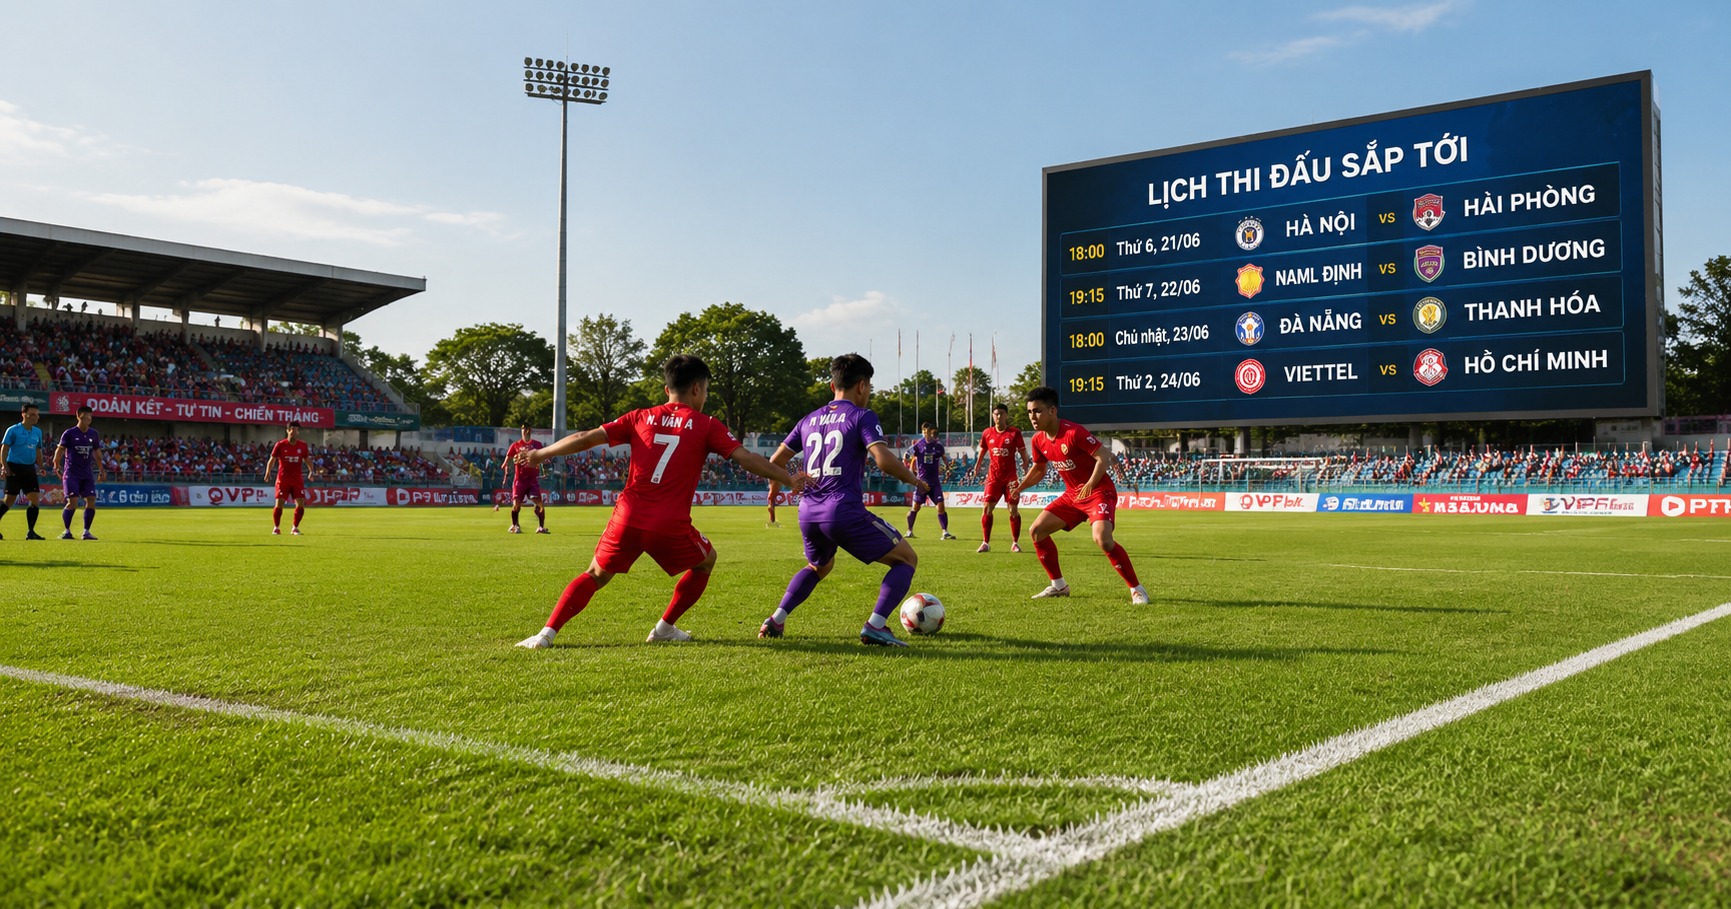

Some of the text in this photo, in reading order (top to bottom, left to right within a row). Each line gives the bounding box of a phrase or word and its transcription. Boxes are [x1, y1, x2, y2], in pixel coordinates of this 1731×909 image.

[1148, 132, 1468, 210] LỊCH THI ĐẤU SẮP TỚI
[1510, 184, 1596, 212] PHÒNG
[1286, 213, 1314, 238] HÀ
[1319, 210, 1355, 236] NỘI
[1069, 243, 1105, 261] 18:00
[1116, 232, 1201, 256] Thứ 6, 21/06
[1463, 245, 1515, 270] BÌNH
[1522, 238, 1605, 264] DƯƠNG
[1275, 262, 1362, 286] NAML ĐỊNH
[1069, 287, 1105, 305] 19:15
[1116, 278, 1201, 301] Thứ 7, 22/06
[1464, 298, 1542, 321] THANH
[1550, 289, 1601, 316] HÓA
[1140, 327, 1171, 347] nhật,
[1173, 324, 1209, 342] 23/06
[1279, 313, 1305, 334] ĐÀ
[1069, 331, 1105, 349] 18:00
[1283, 363, 1358, 383] VIETTEL
[1464, 348, 1608, 374] HỒ CHÍ MINH
[1069, 376, 1104, 393] 19:15
[1115, 371, 1201, 392] Thứ 2, 24/06
[653, 433, 680, 484] 7
[806, 430, 844, 477] 22
